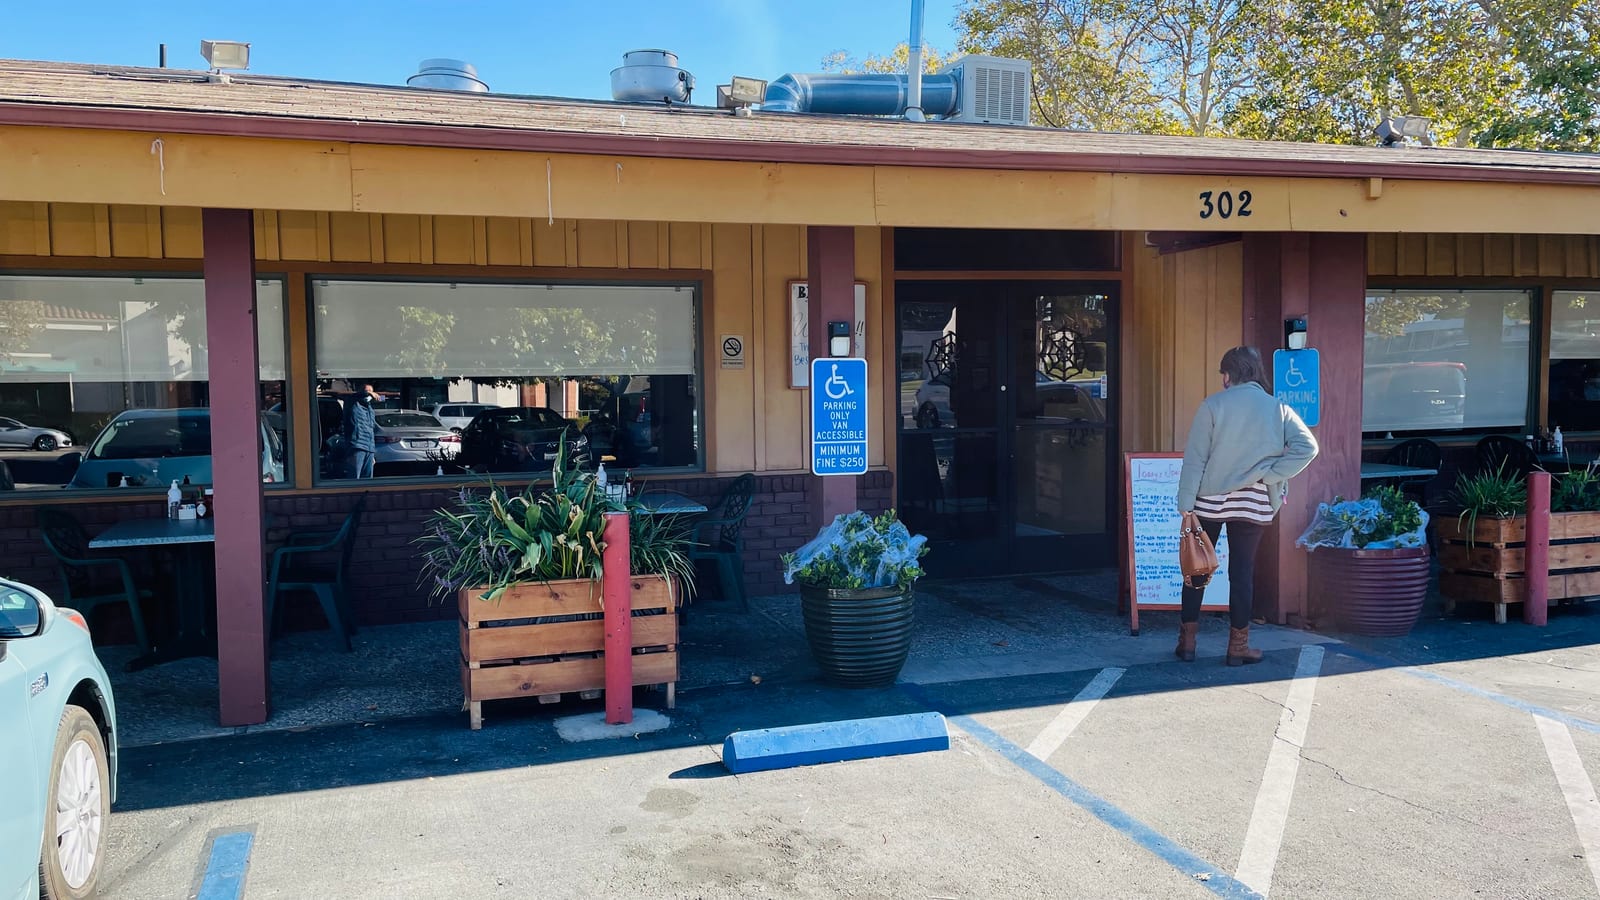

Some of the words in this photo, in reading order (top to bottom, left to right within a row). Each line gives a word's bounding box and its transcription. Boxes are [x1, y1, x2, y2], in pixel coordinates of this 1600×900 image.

[1199, 190, 1252, 219] 302
[1277, 390, 1317, 404] PARKING
[823, 401, 857, 411] PARKING
[830, 411, 850, 420] ONLY
[832, 421, 848, 430] VAN
[816, 430, 864, 441] ACCESSIBLE
[820, 444, 860, 456] MINIMUM
[816, 457, 837, 469] FINE
[839, 456, 864, 468] $250
